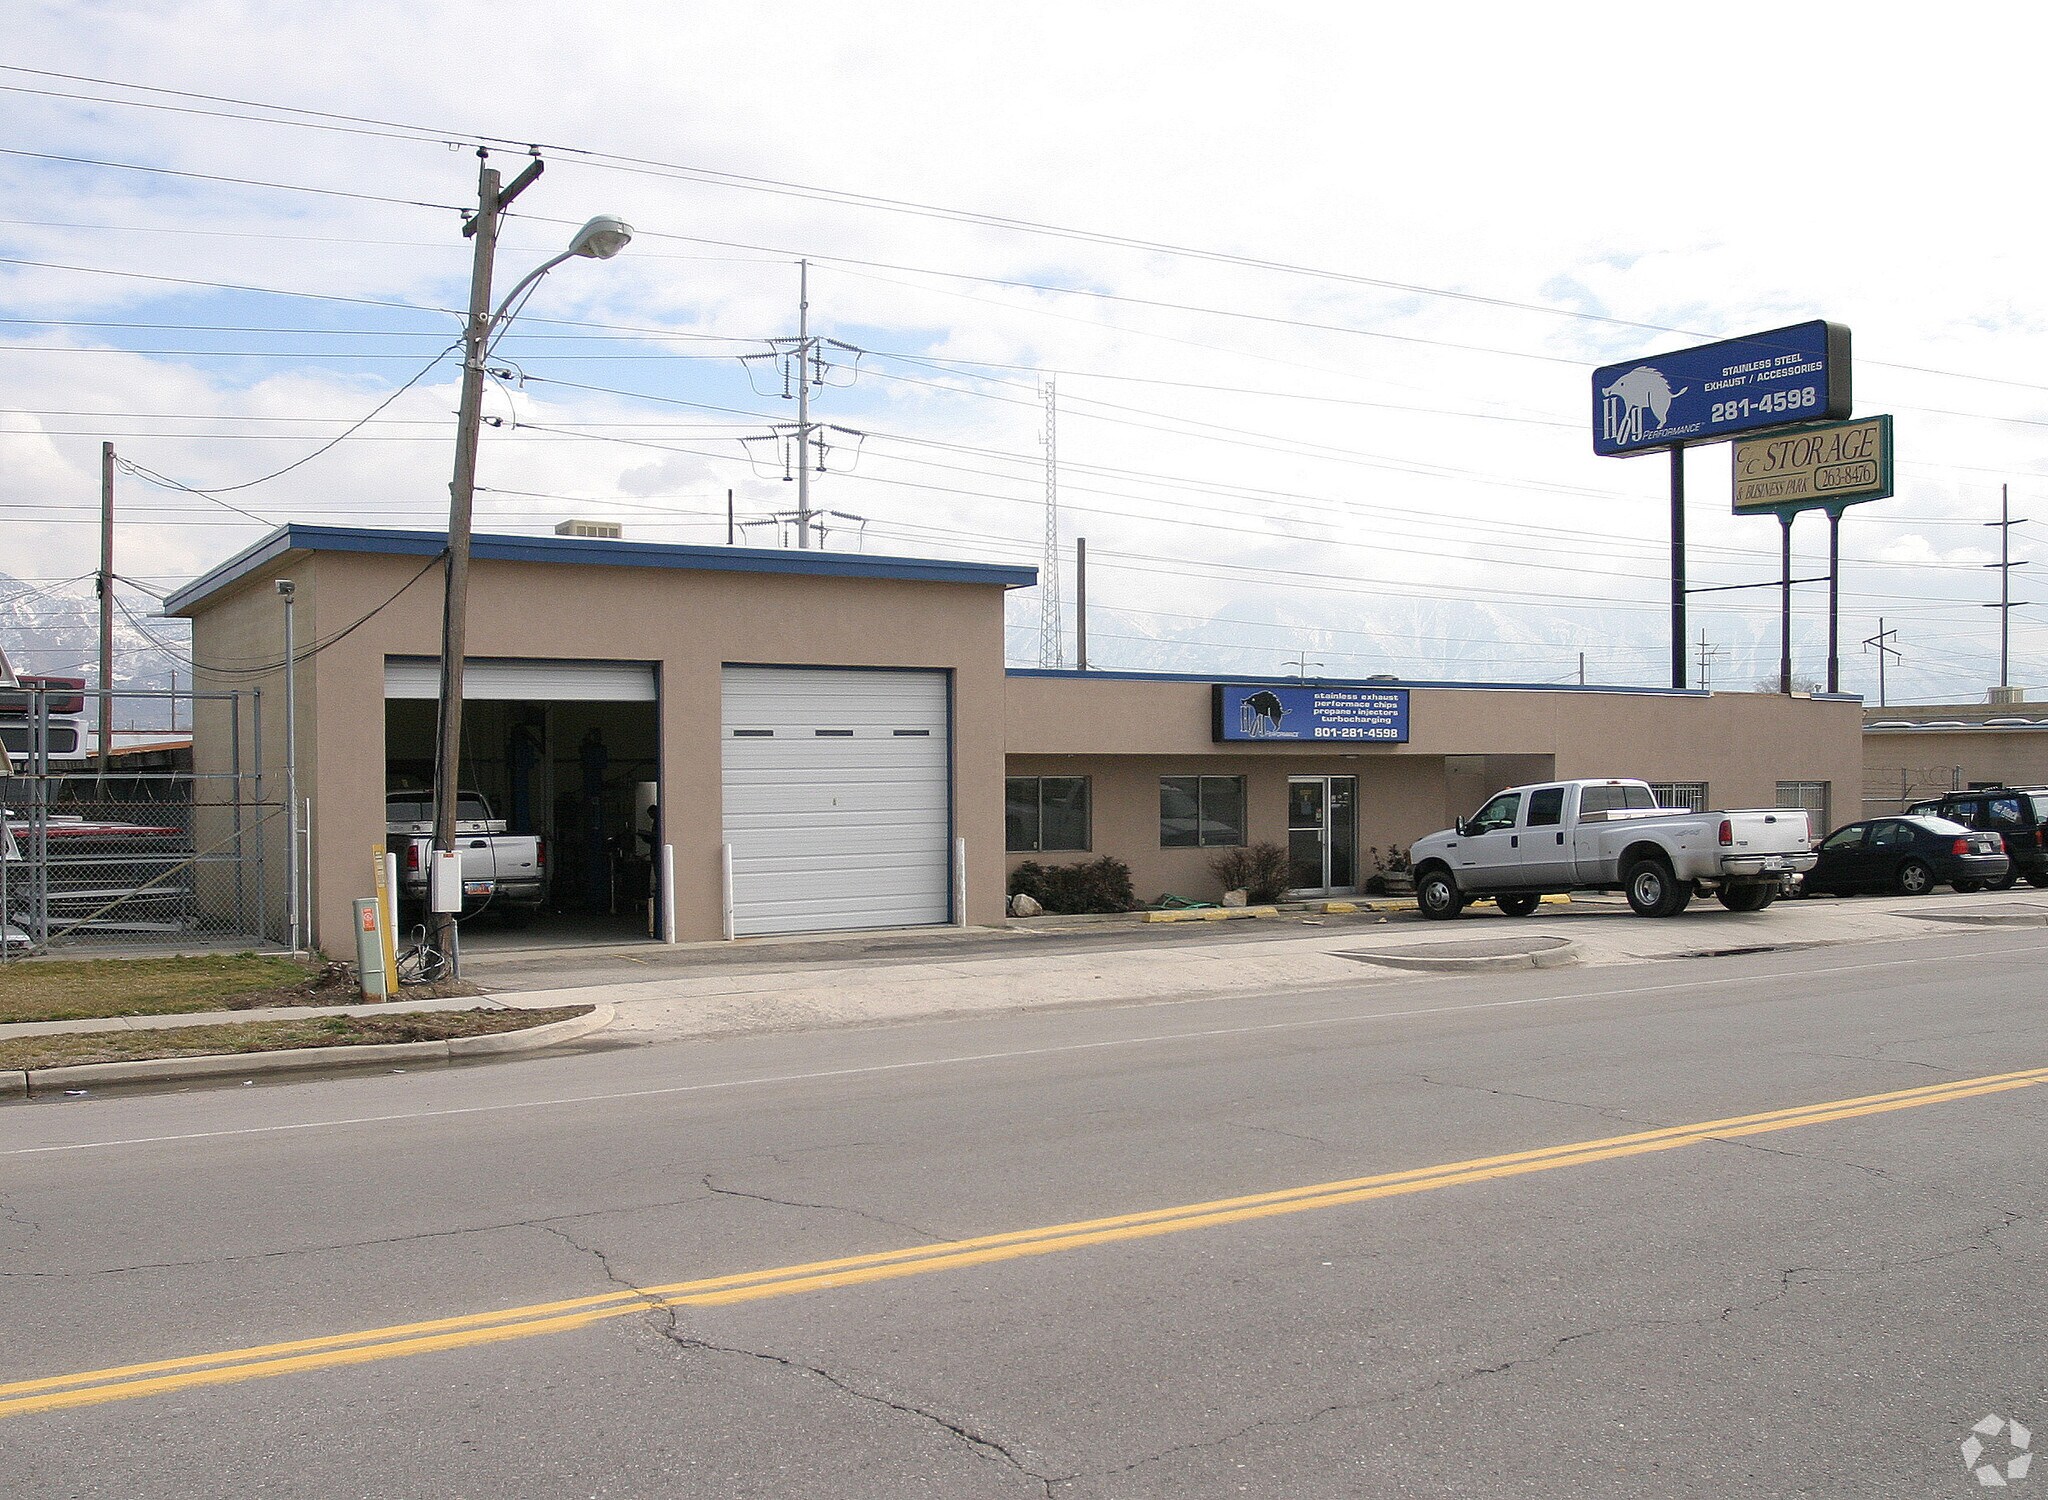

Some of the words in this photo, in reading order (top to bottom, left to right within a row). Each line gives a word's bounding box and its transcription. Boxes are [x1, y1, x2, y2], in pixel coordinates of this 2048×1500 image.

[1704, 376, 1747, 392] EXHAUST
[1757, 361, 1823, 382] ACCESSORIES
[1722, 359, 1772, 377] STAINLESS
[1774, 353, 1803, 367] STEEL
[1711, 386, 1816, 423] 281-4598
[1763, 427, 1877, 472] STORAGE
[1822, 464, 1871, 488] 263-8476
[1745, 480, 1785, 500] BUSINESS
[1785, 477, 1809, 495] PARK
[1314, 692, 1358, 700] stainless
[1361, 693, 1399, 701] exhaust
[1373, 701, 1398, 709] chips
[1313, 708, 1352, 716] propane
[1358, 708, 1399, 716] injectors
[1321, 716, 1392, 725] turbocharging
[1314, 727, 1398, 738] 801-281-4598
